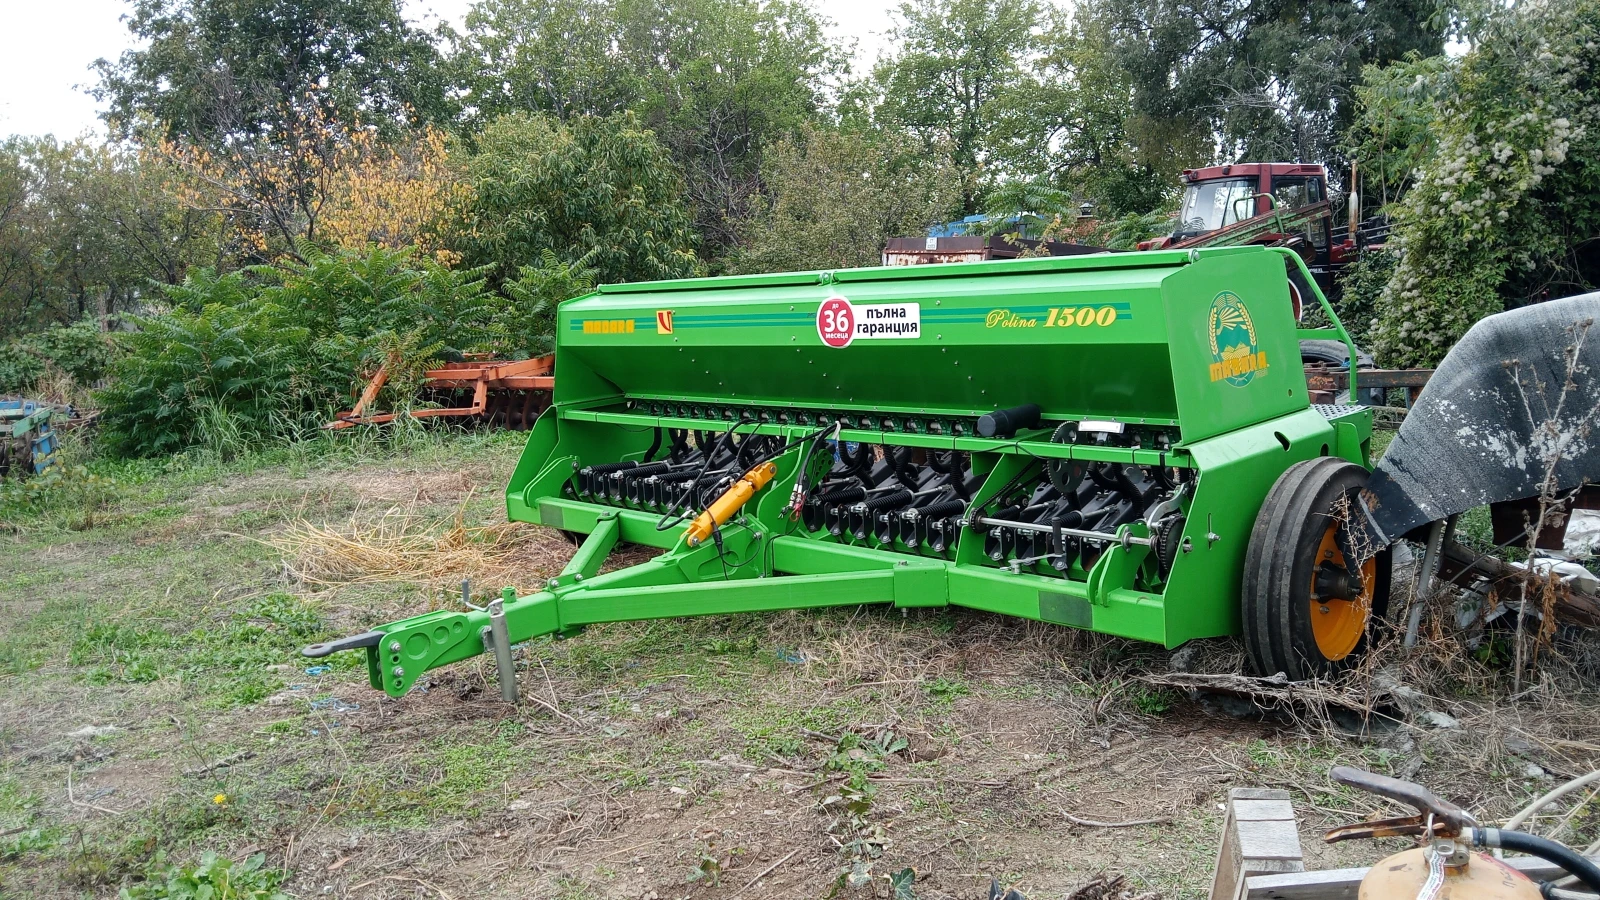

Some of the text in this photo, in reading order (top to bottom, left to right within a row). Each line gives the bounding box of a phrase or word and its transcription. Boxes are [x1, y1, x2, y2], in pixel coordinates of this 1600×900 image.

[866, 307, 906, 319] пълна
[985, 306, 1117, 329] Polina 1500
[824, 309, 849, 333] 36
[825, 332, 849, 340] месеца
[857, 322, 918, 337] гаранция
